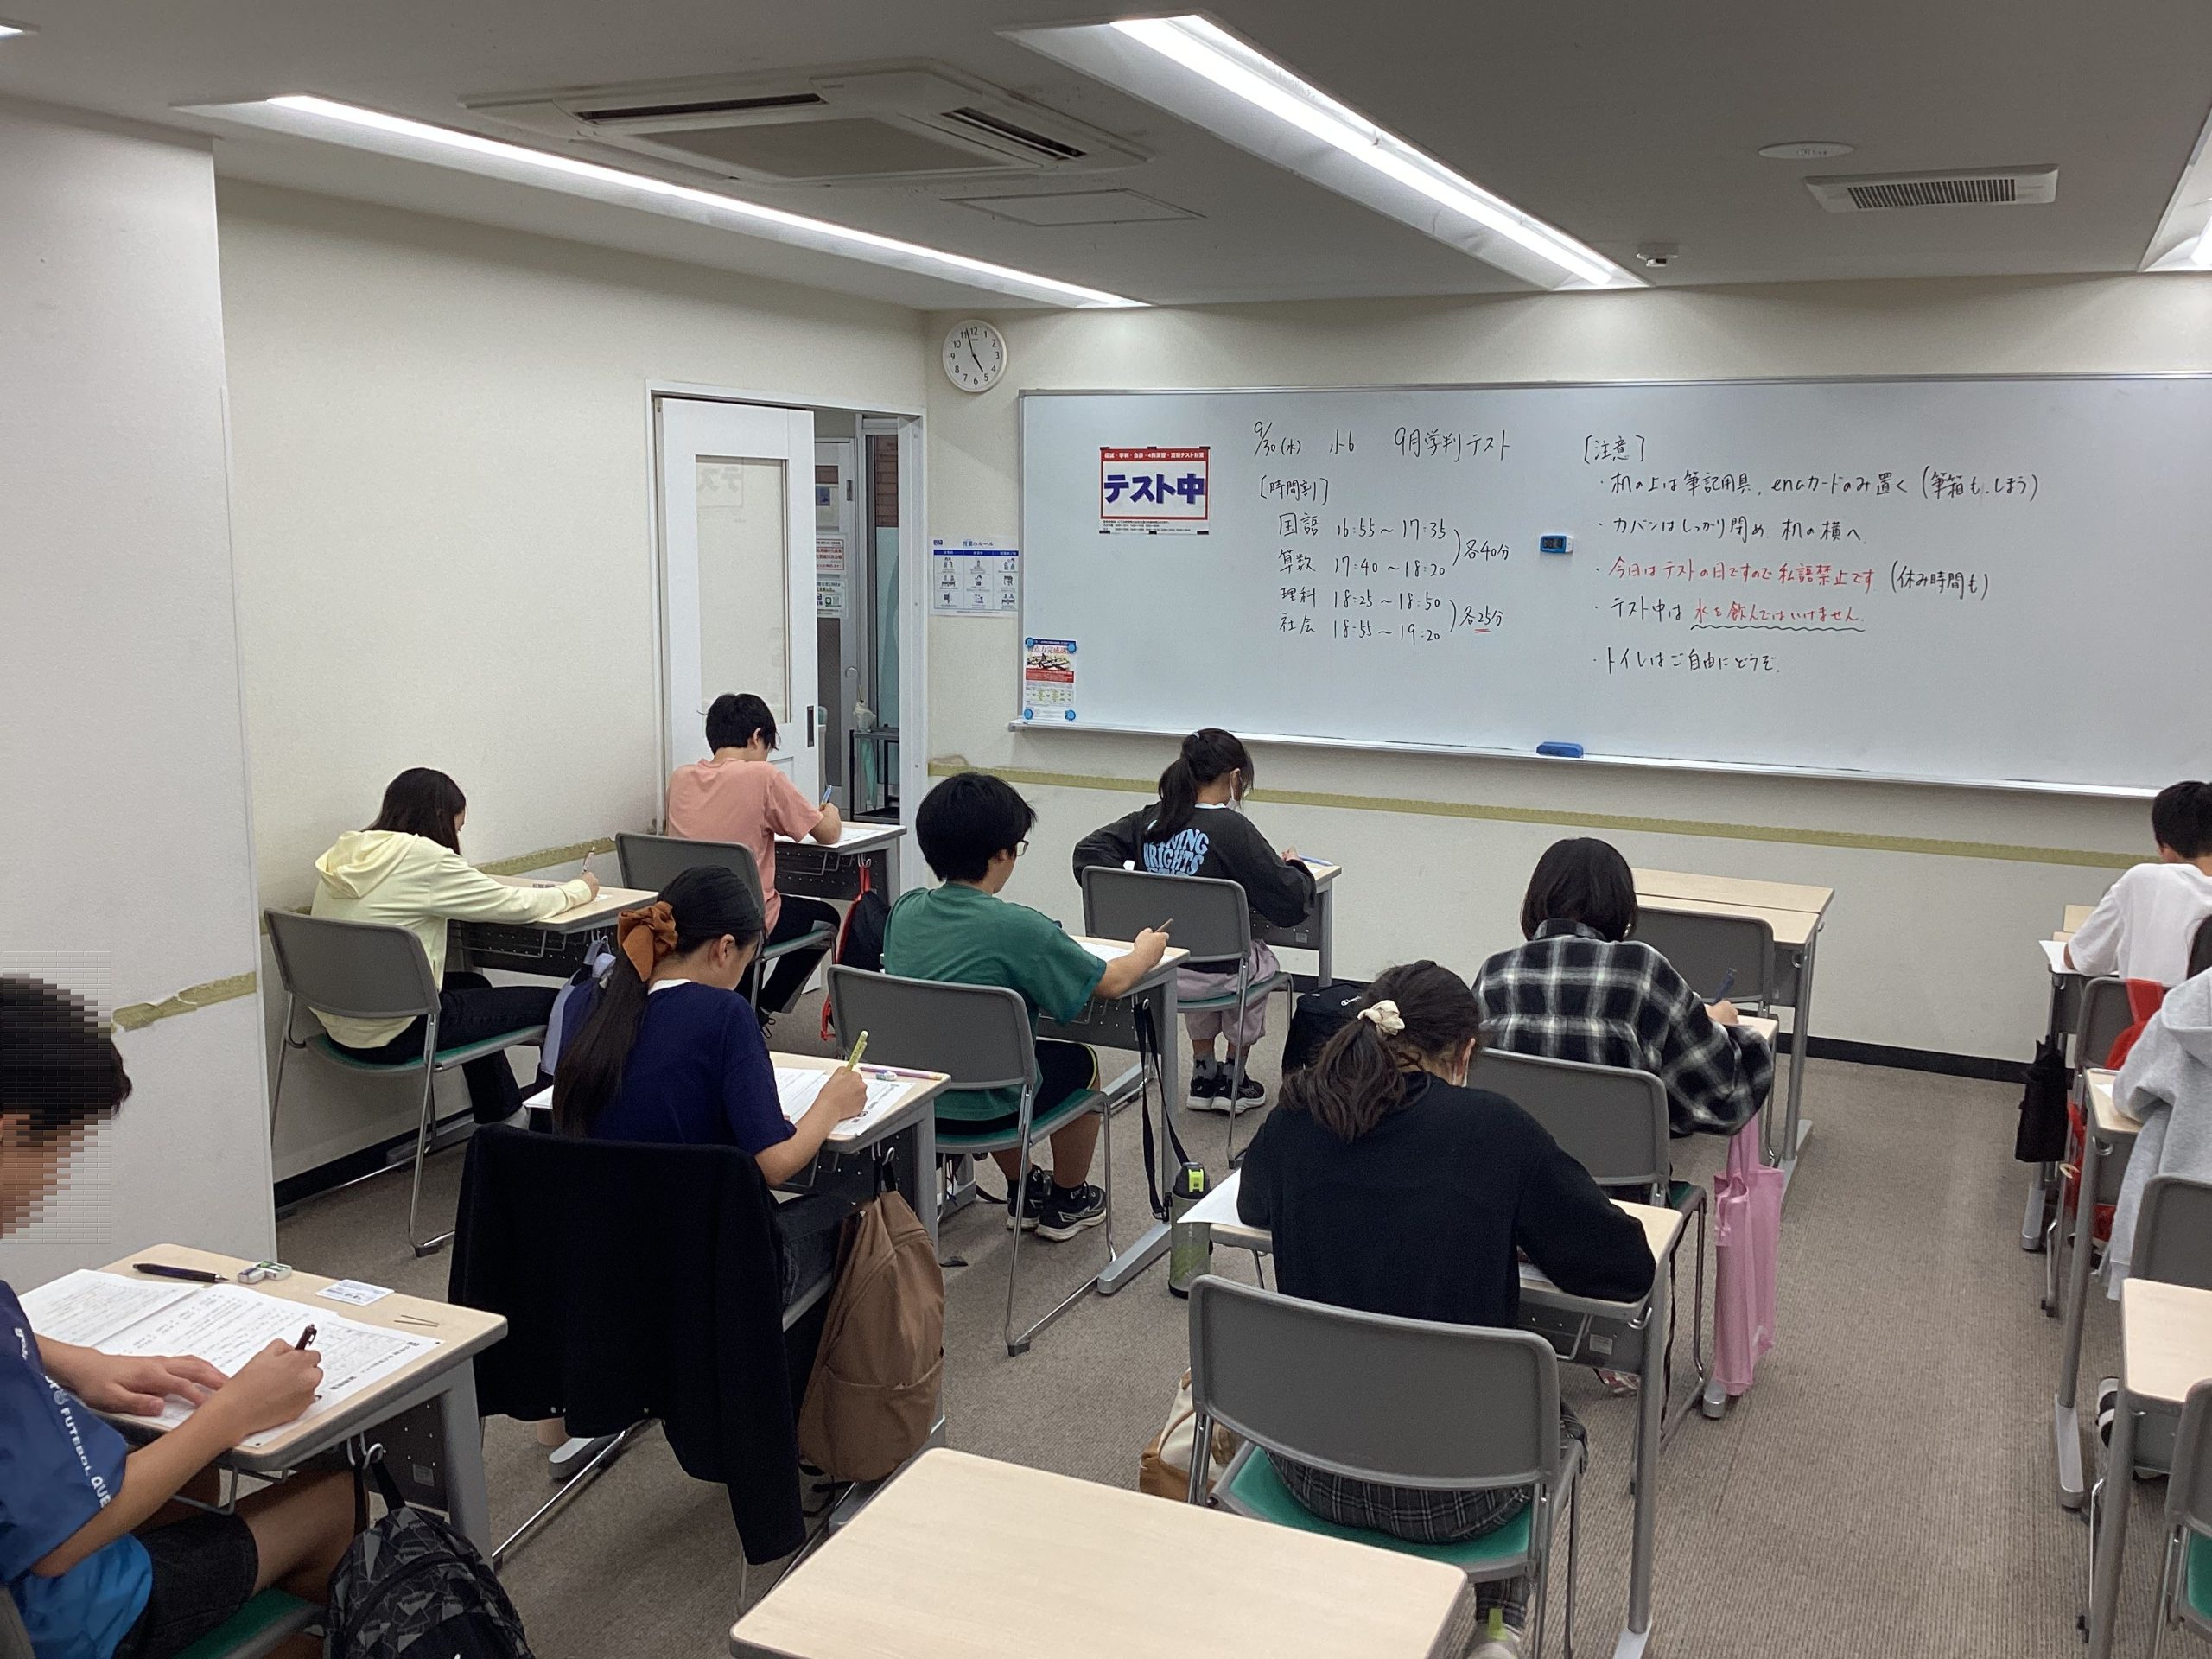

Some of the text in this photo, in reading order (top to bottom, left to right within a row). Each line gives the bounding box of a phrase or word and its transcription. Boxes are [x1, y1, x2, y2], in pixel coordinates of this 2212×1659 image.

[970, 327, 978, 335] 12
[991, 339, 996, 347] 2
[995, 351, 1000, 359] 3
[955, 365, 960, 374] 8
[963, 373, 968, 382] 7
[984, 373, 988, 382] 5
[1104, 473, 1205, 504] テスト中
[1279, 513, 1319, 537] 国語
[1278, 549, 1316, 574] 算数
[1281, 587, 1316, 607] 理科
[1279, 612, 1316, 635] 社会
[60, 1407, 92, 1477] FUTEBOL
